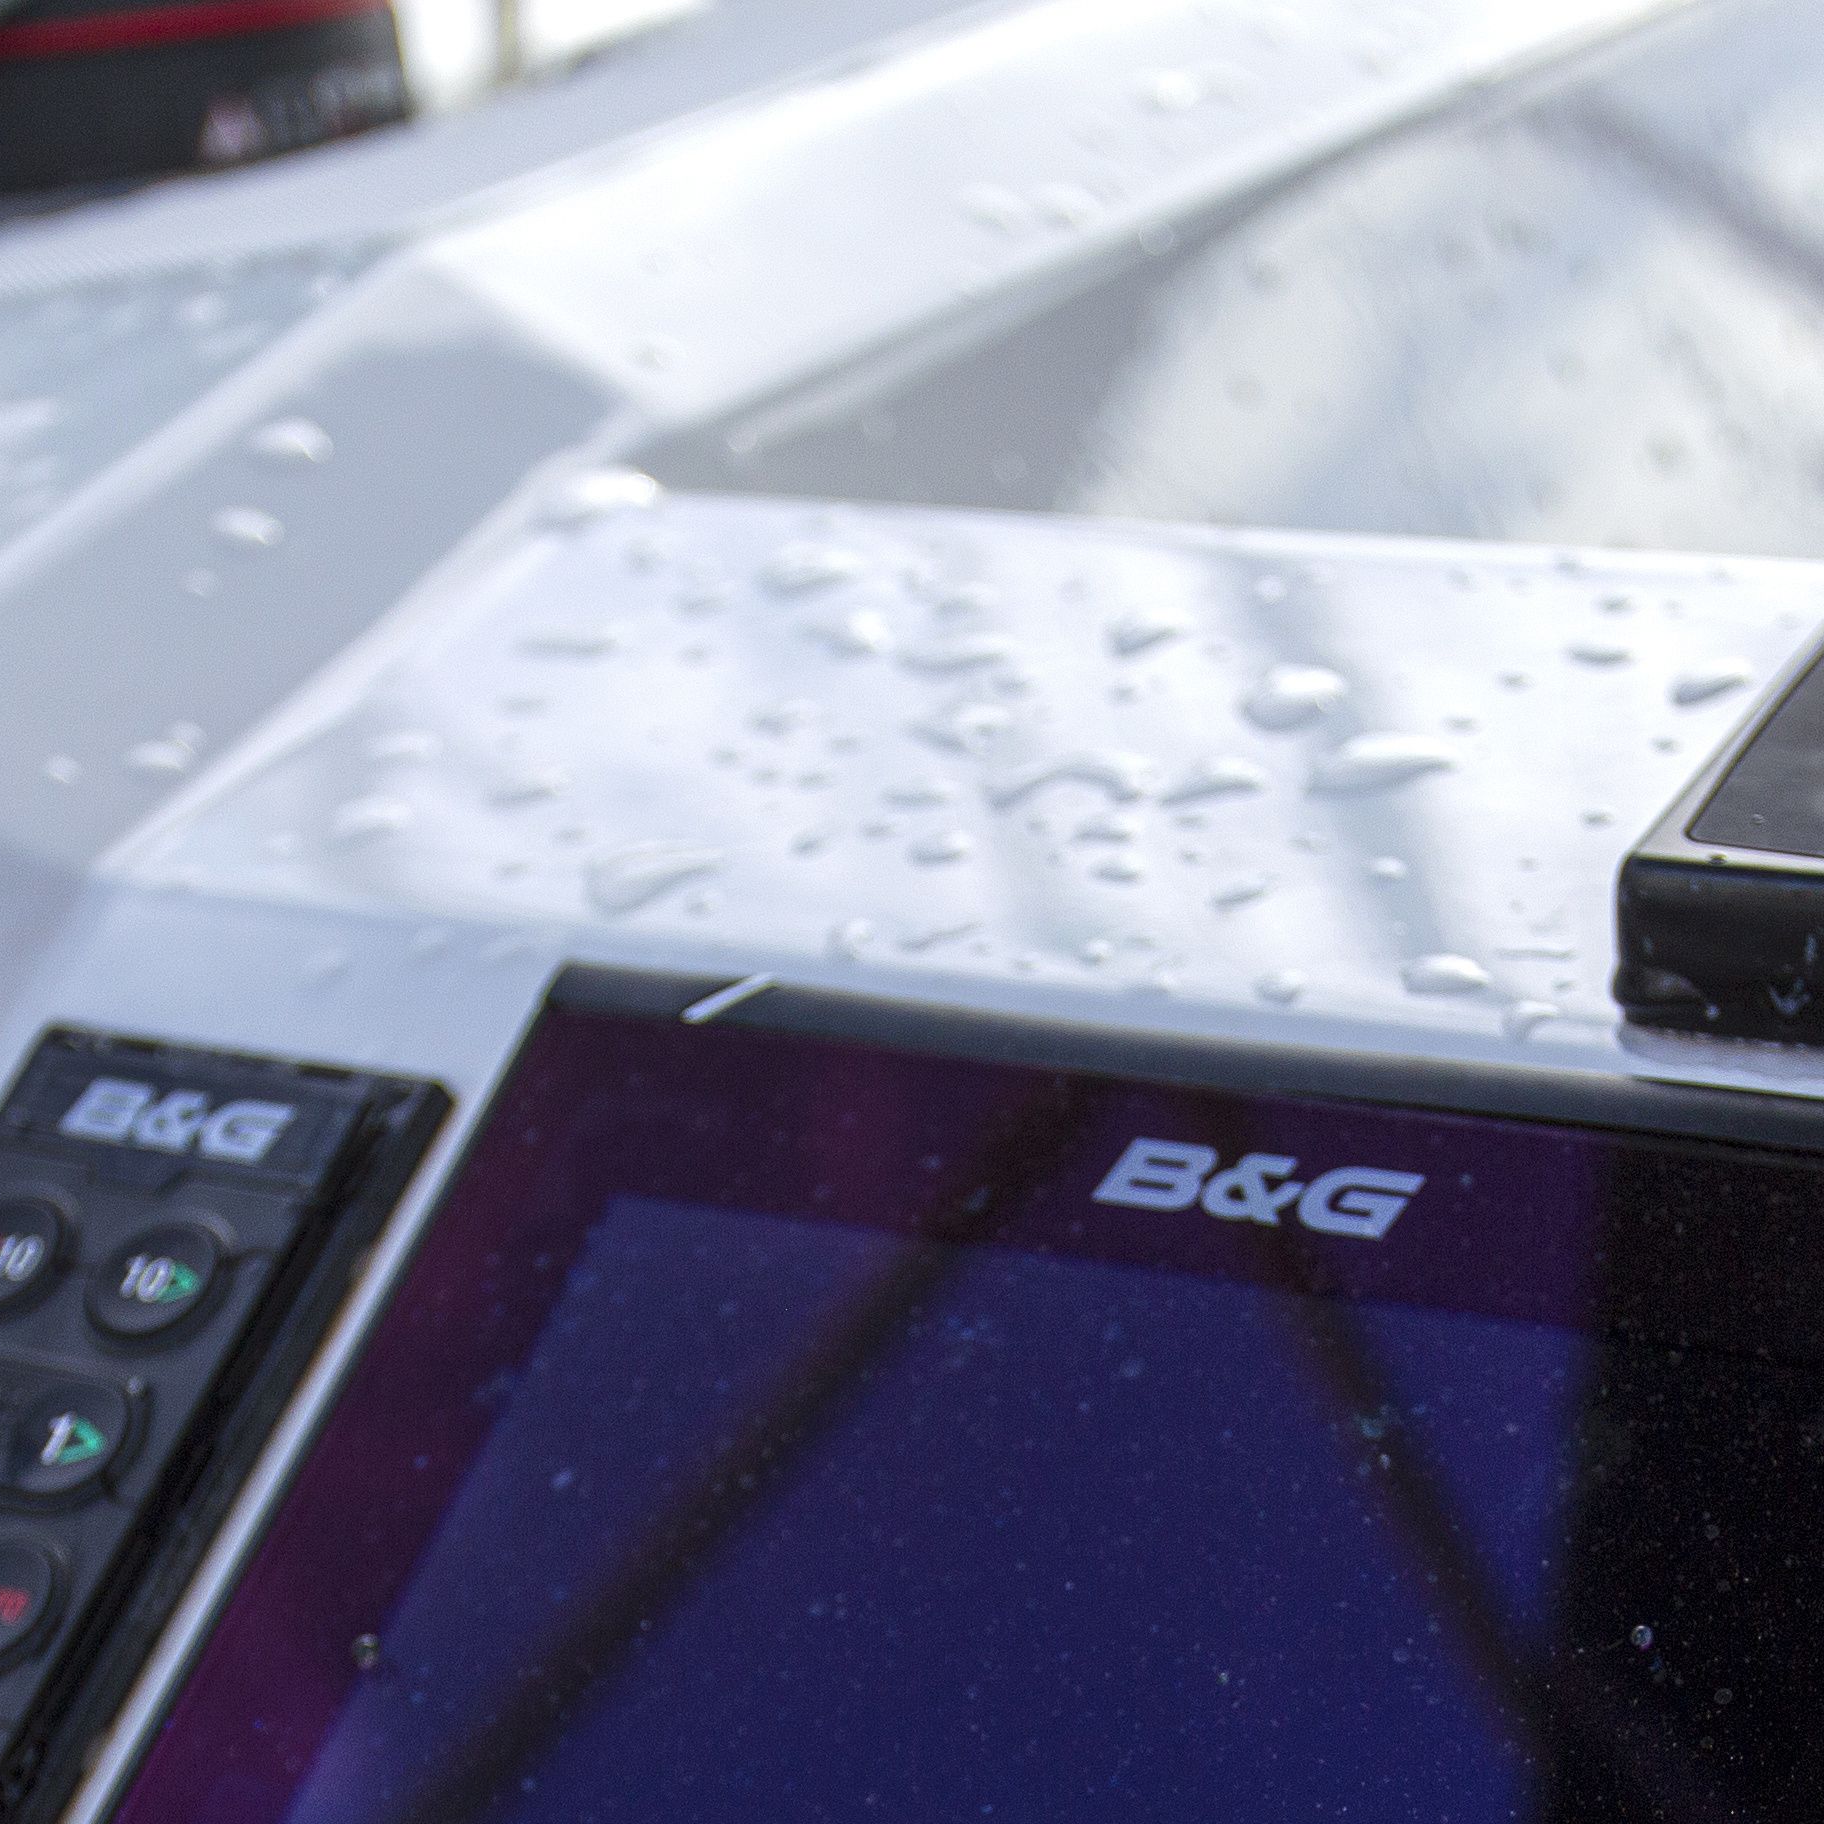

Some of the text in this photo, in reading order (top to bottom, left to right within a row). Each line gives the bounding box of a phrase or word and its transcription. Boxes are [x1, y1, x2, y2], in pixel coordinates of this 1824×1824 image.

[56, 1077, 295, 1165] B&G
[1091, 1136, 1428, 1241] B&G
[120, 1253, 175, 1304] 10
